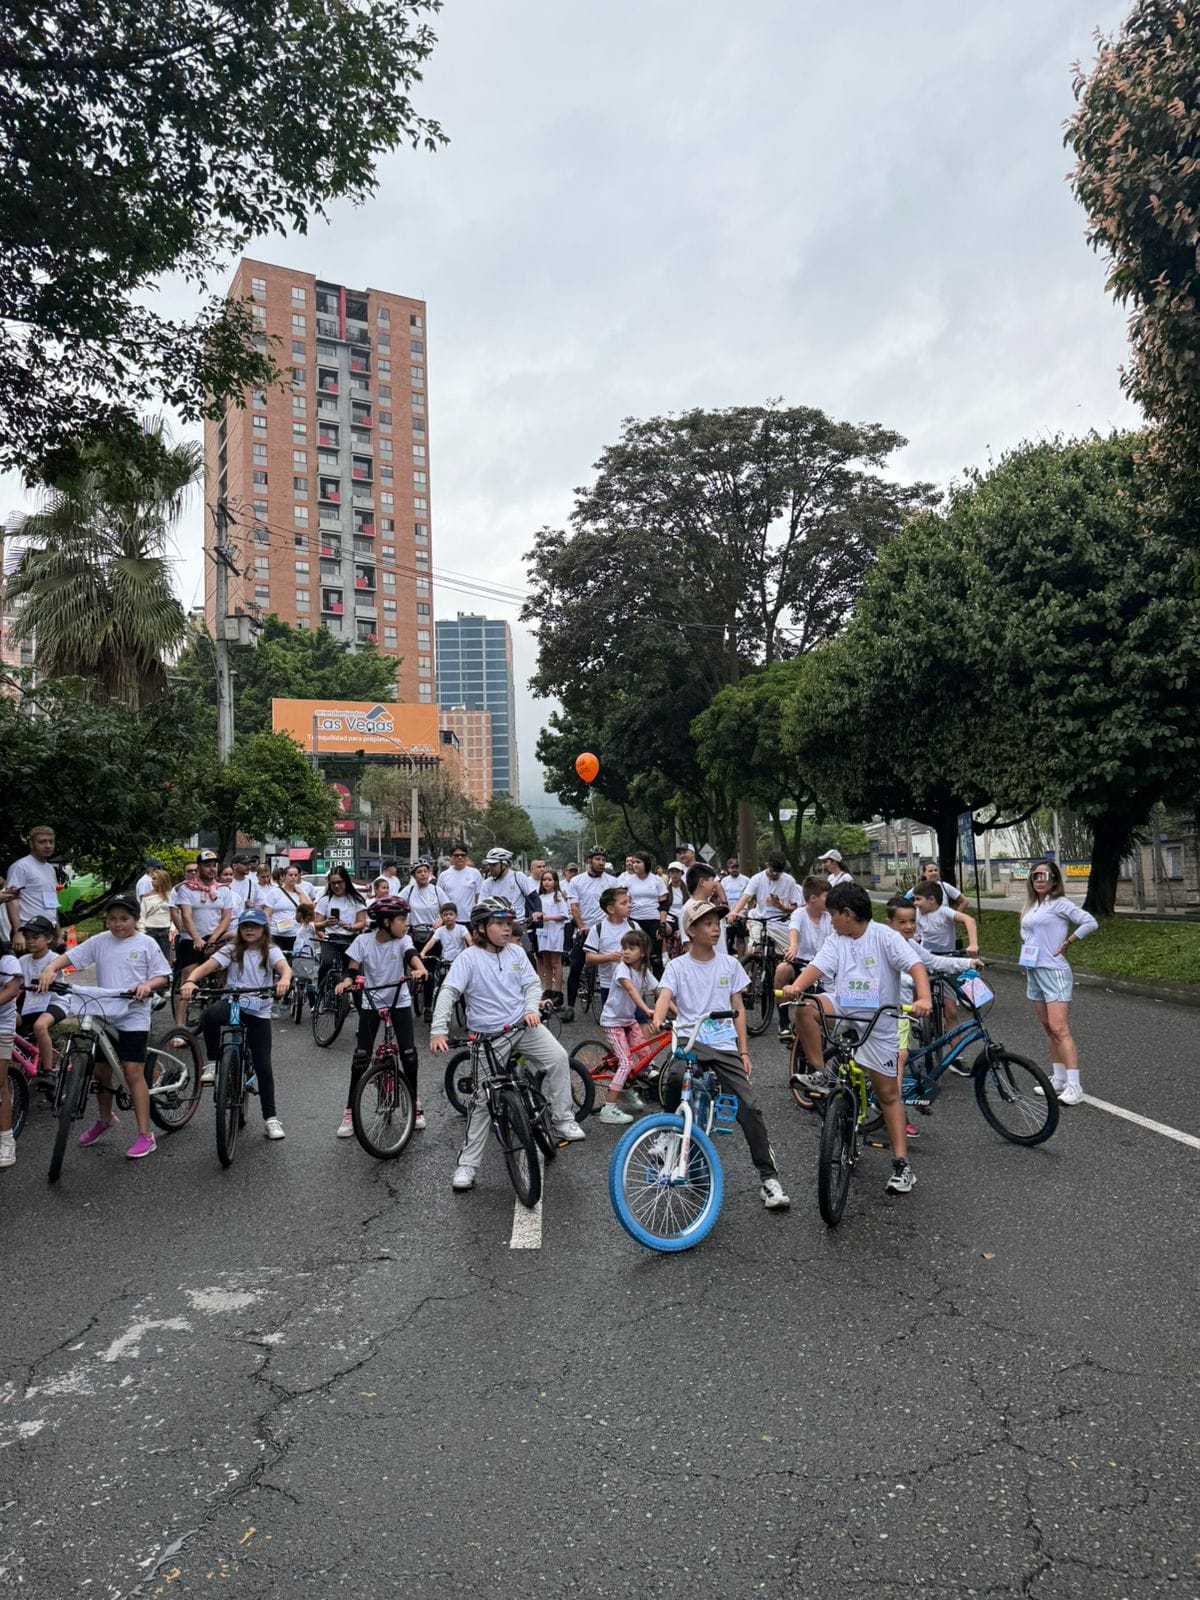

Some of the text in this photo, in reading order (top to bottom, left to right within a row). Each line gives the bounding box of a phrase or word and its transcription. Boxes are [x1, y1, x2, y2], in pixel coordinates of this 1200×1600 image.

[315, 717, 394, 732] Las Vegas
[307, 734, 347, 742] Trnquilidad
[848, 981, 870, 990] 326
